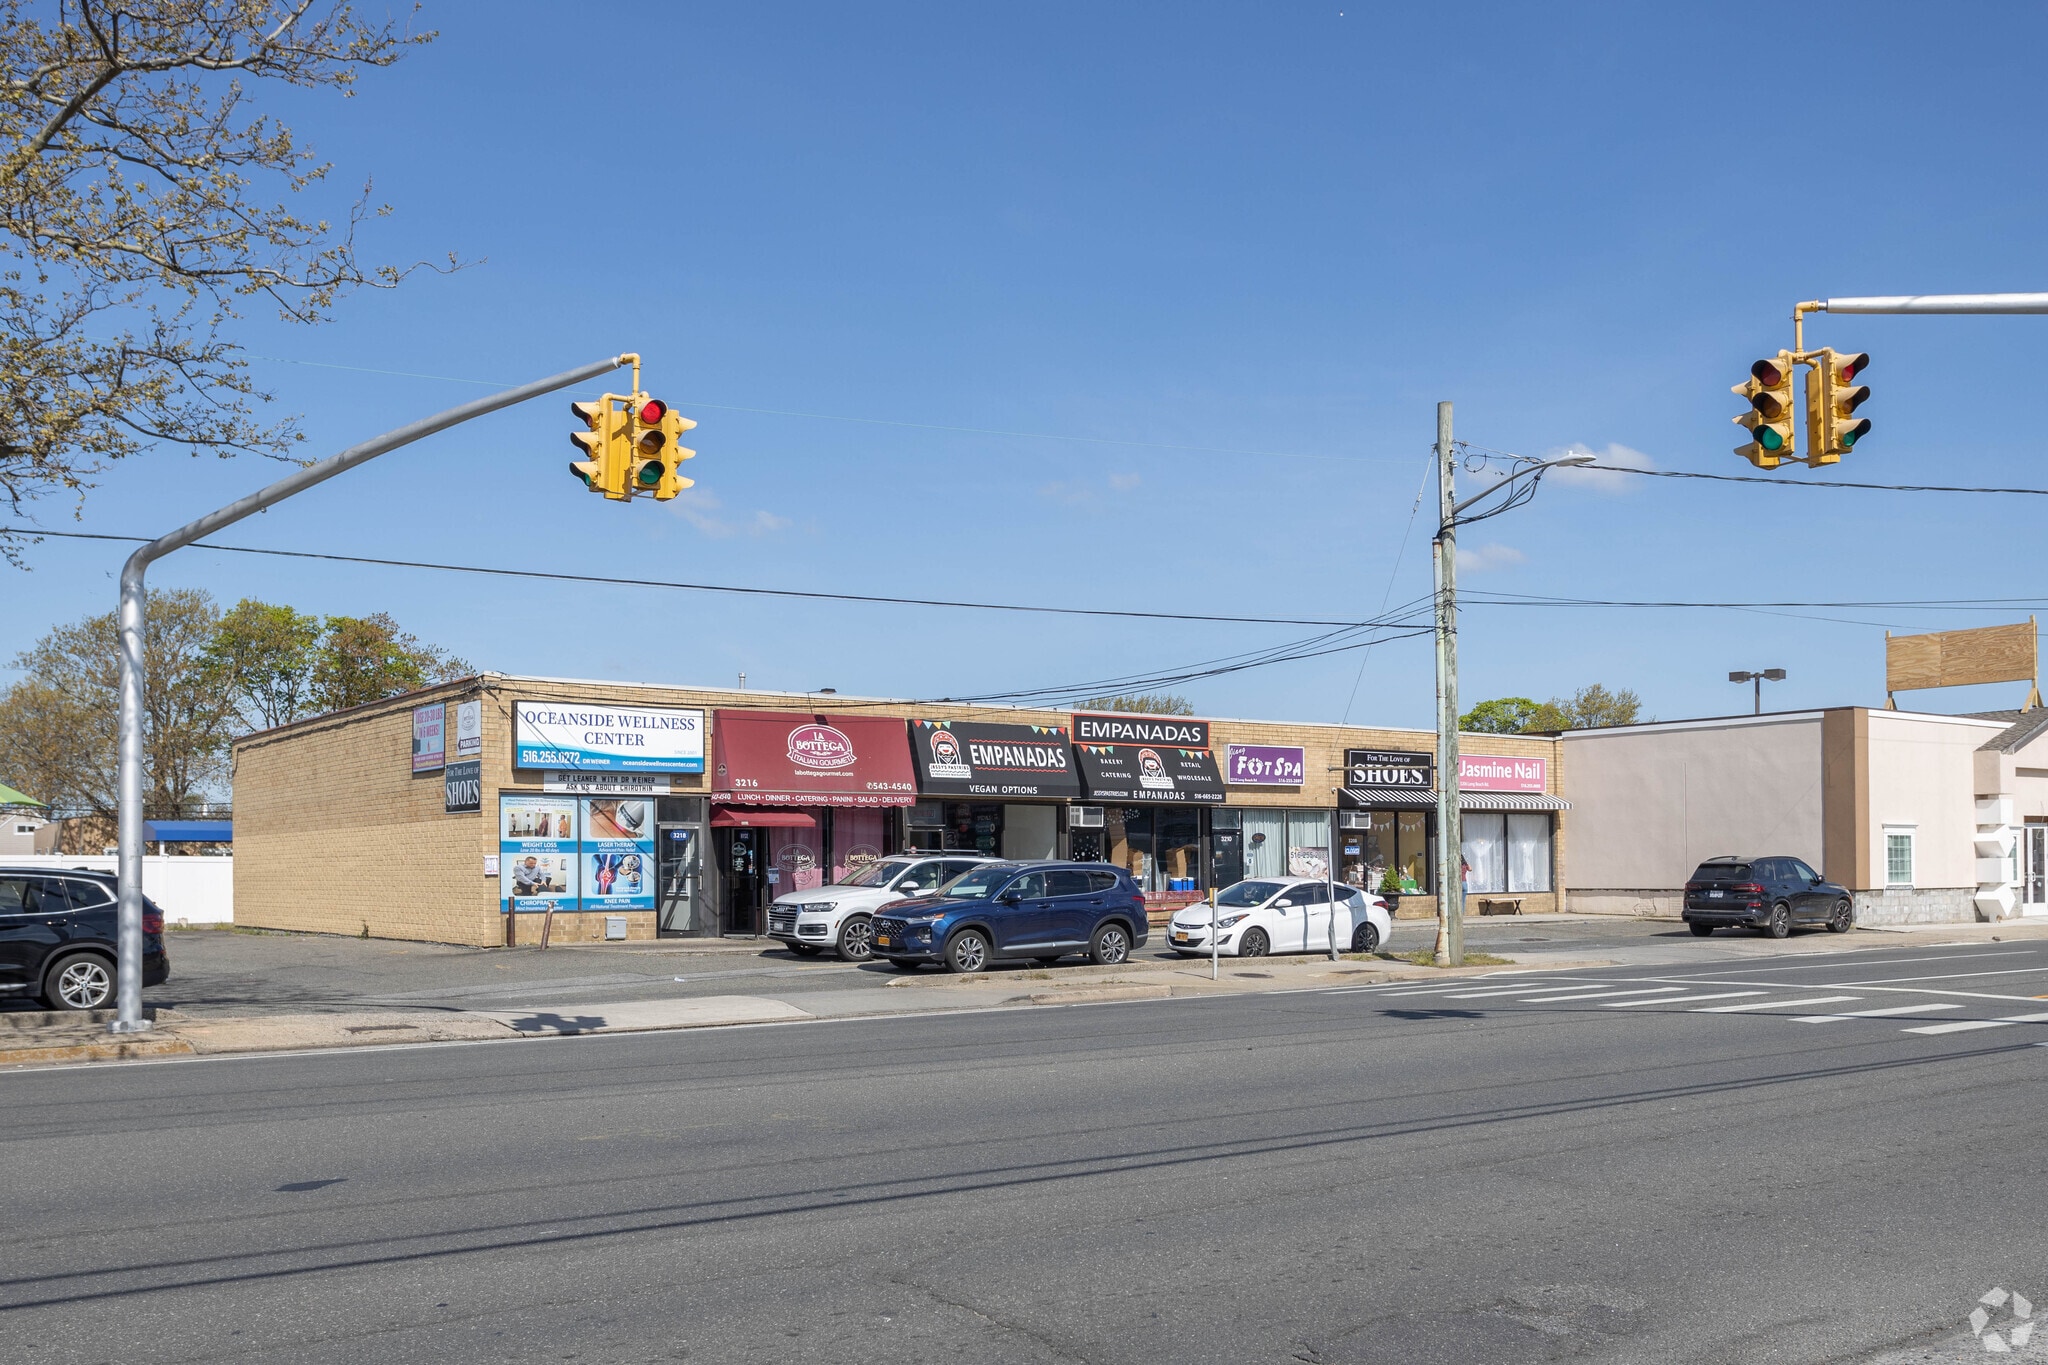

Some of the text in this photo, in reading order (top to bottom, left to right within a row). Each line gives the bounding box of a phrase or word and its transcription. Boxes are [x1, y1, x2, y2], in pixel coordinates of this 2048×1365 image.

[525, 710, 696, 731] OCEANSIDE WELLNESS
[813, 732, 825, 741] LA
[1081, 721, 1201, 742] EMPANADAS
[460, 738, 479, 749] PARKING
[584, 732, 645, 746] CENTER
[796, 740, 845, 752] BOTTEGA
[522, 750, 580, 764] 516.255.0272
[794, 754, 851, 766] ITALIAN GOURMET
[969, 744, 1066, 768] EMPANADAS
[622, 760, 698, 768] oceansidewellnesscenter.com
[1460, 760, 1540, 779] Jasmine Nail
[454, 767, 462, 776] THE
[463, 766, 473, 775] LOVE
[474, 766, 479, 774] OF
[1354, 764, 1423, 784] SHOES
[558, 774, 570, 782] GET
[601, 775, 618, 783] WITH
[632, 776, 655, 784] WEINER
[736, 779, 758, 787] 3216
[1177, 774, 1212, 782] WHOLESALE
[620, 784, 653, 792] CHIROTHIN
[873, 782, 912, 790] 543-4540
[969, 785, 1038, 794] VEGAN OPTIONS
[446, 780, 479, 806] SHOES
[1133, 790, 1185, 800] EMPANADAS
